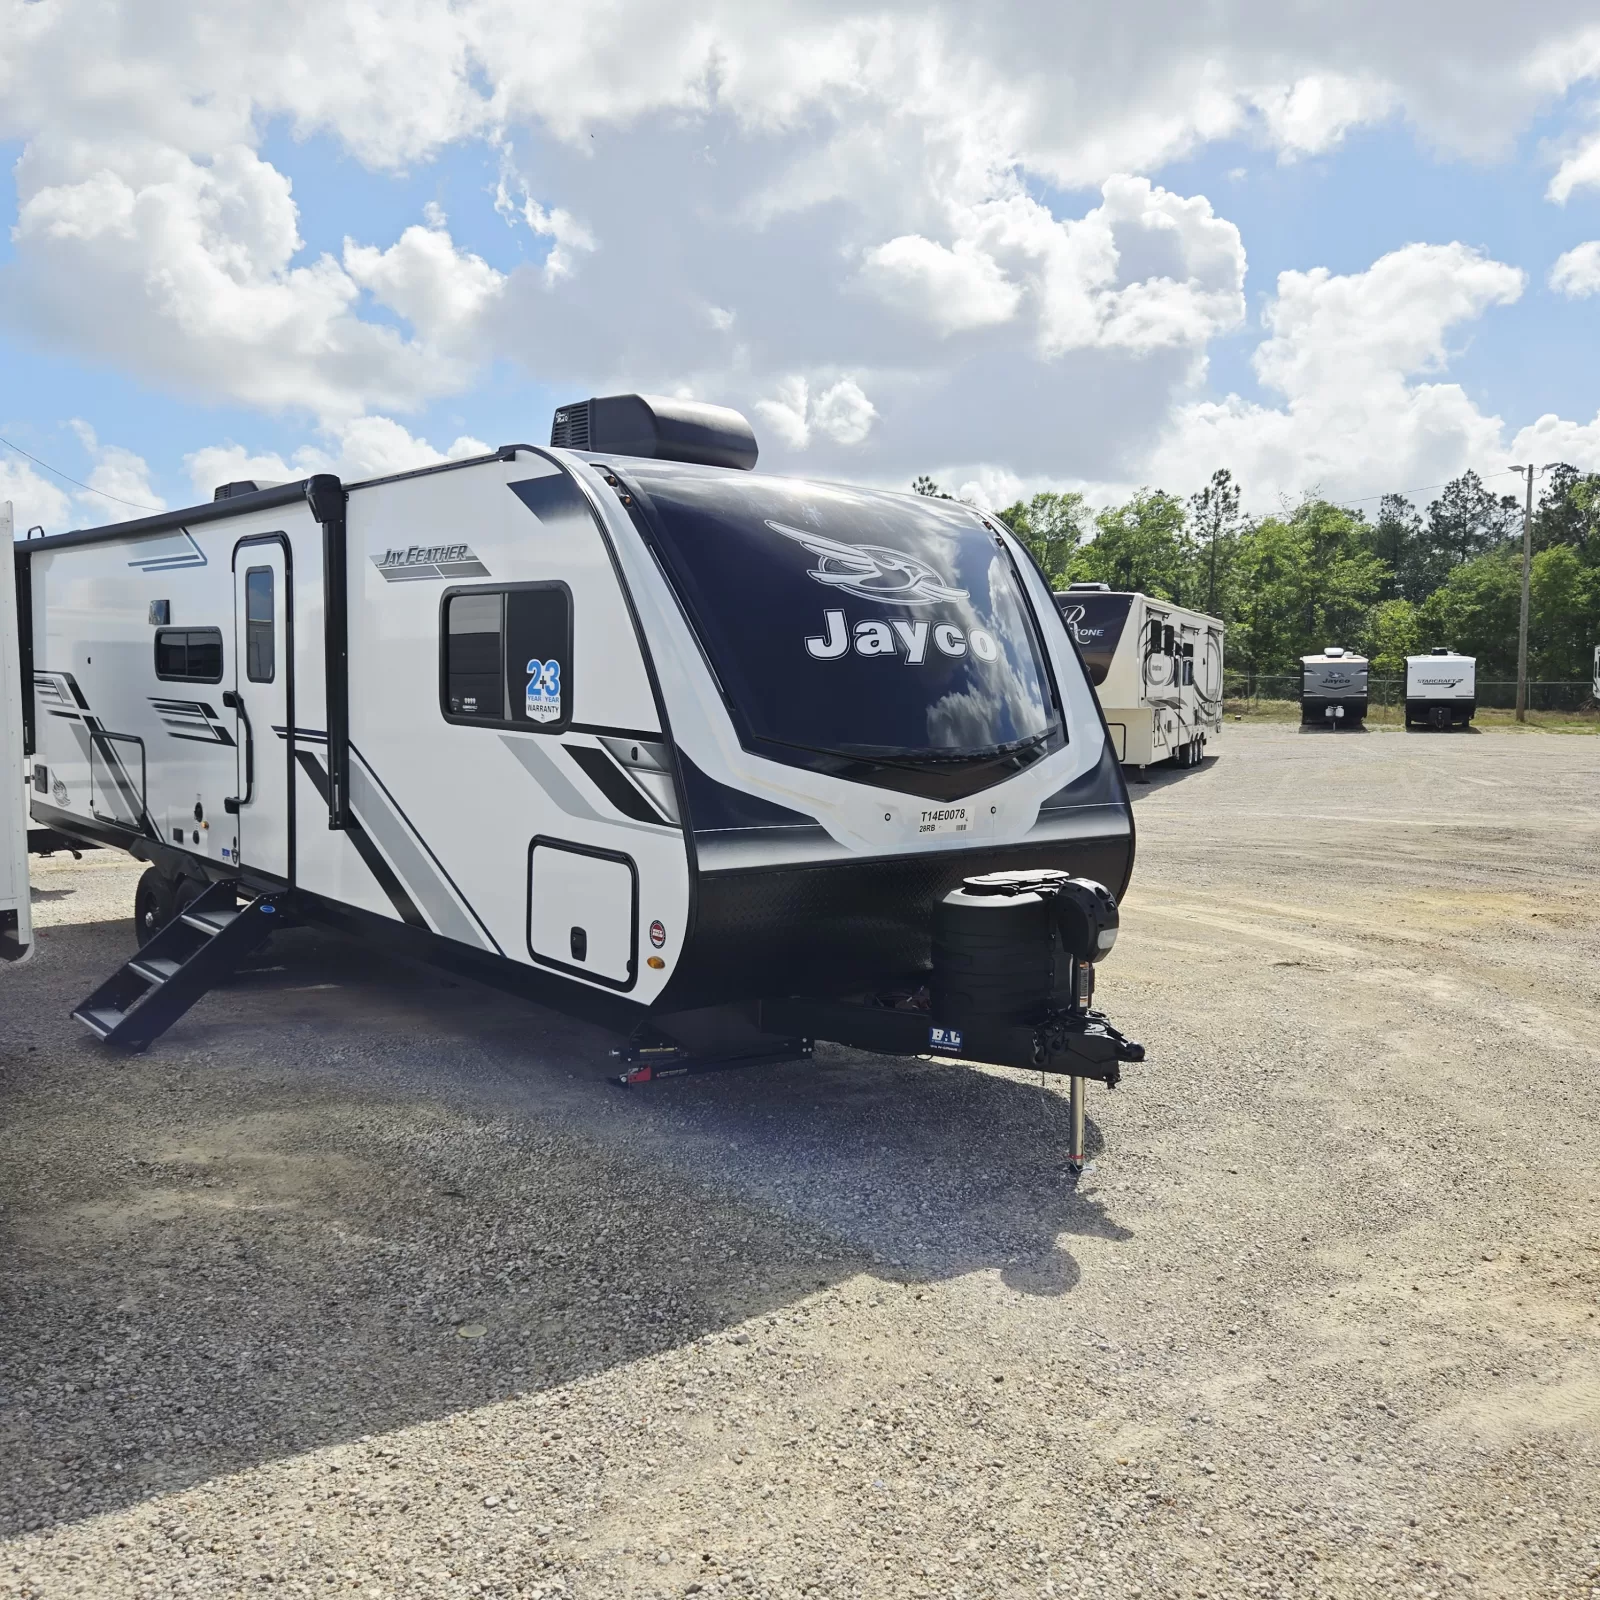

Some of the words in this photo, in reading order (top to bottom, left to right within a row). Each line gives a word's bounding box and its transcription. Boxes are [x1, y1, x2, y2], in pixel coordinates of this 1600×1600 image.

[377, 548, 406, 569] JAY
[405, 543, 468, 566] FEATHER
[804, 608, 999, 665] Jayco
[1322, 677, 1351, 685] Jayco
[528, 704, 560, 713] WARRANTY
[921, 808, 966, 823] T14E0078
